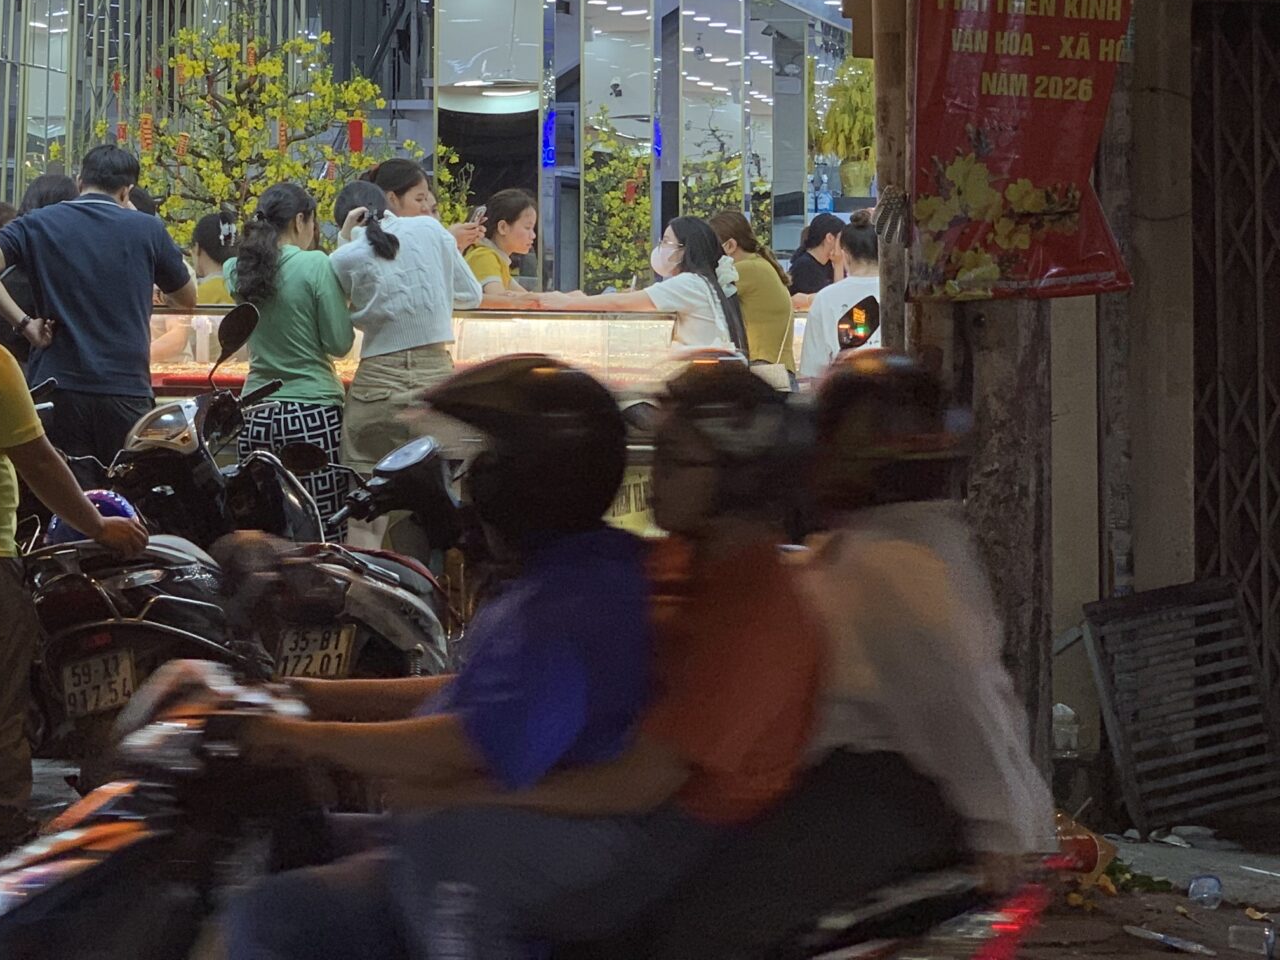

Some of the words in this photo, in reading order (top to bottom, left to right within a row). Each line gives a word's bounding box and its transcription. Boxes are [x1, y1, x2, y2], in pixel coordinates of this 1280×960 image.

[1058, 33, 1091, 60] XÃ
[982, 68, 1027, 97] NĂM
[1034, 76, 1093, 101] 2026
